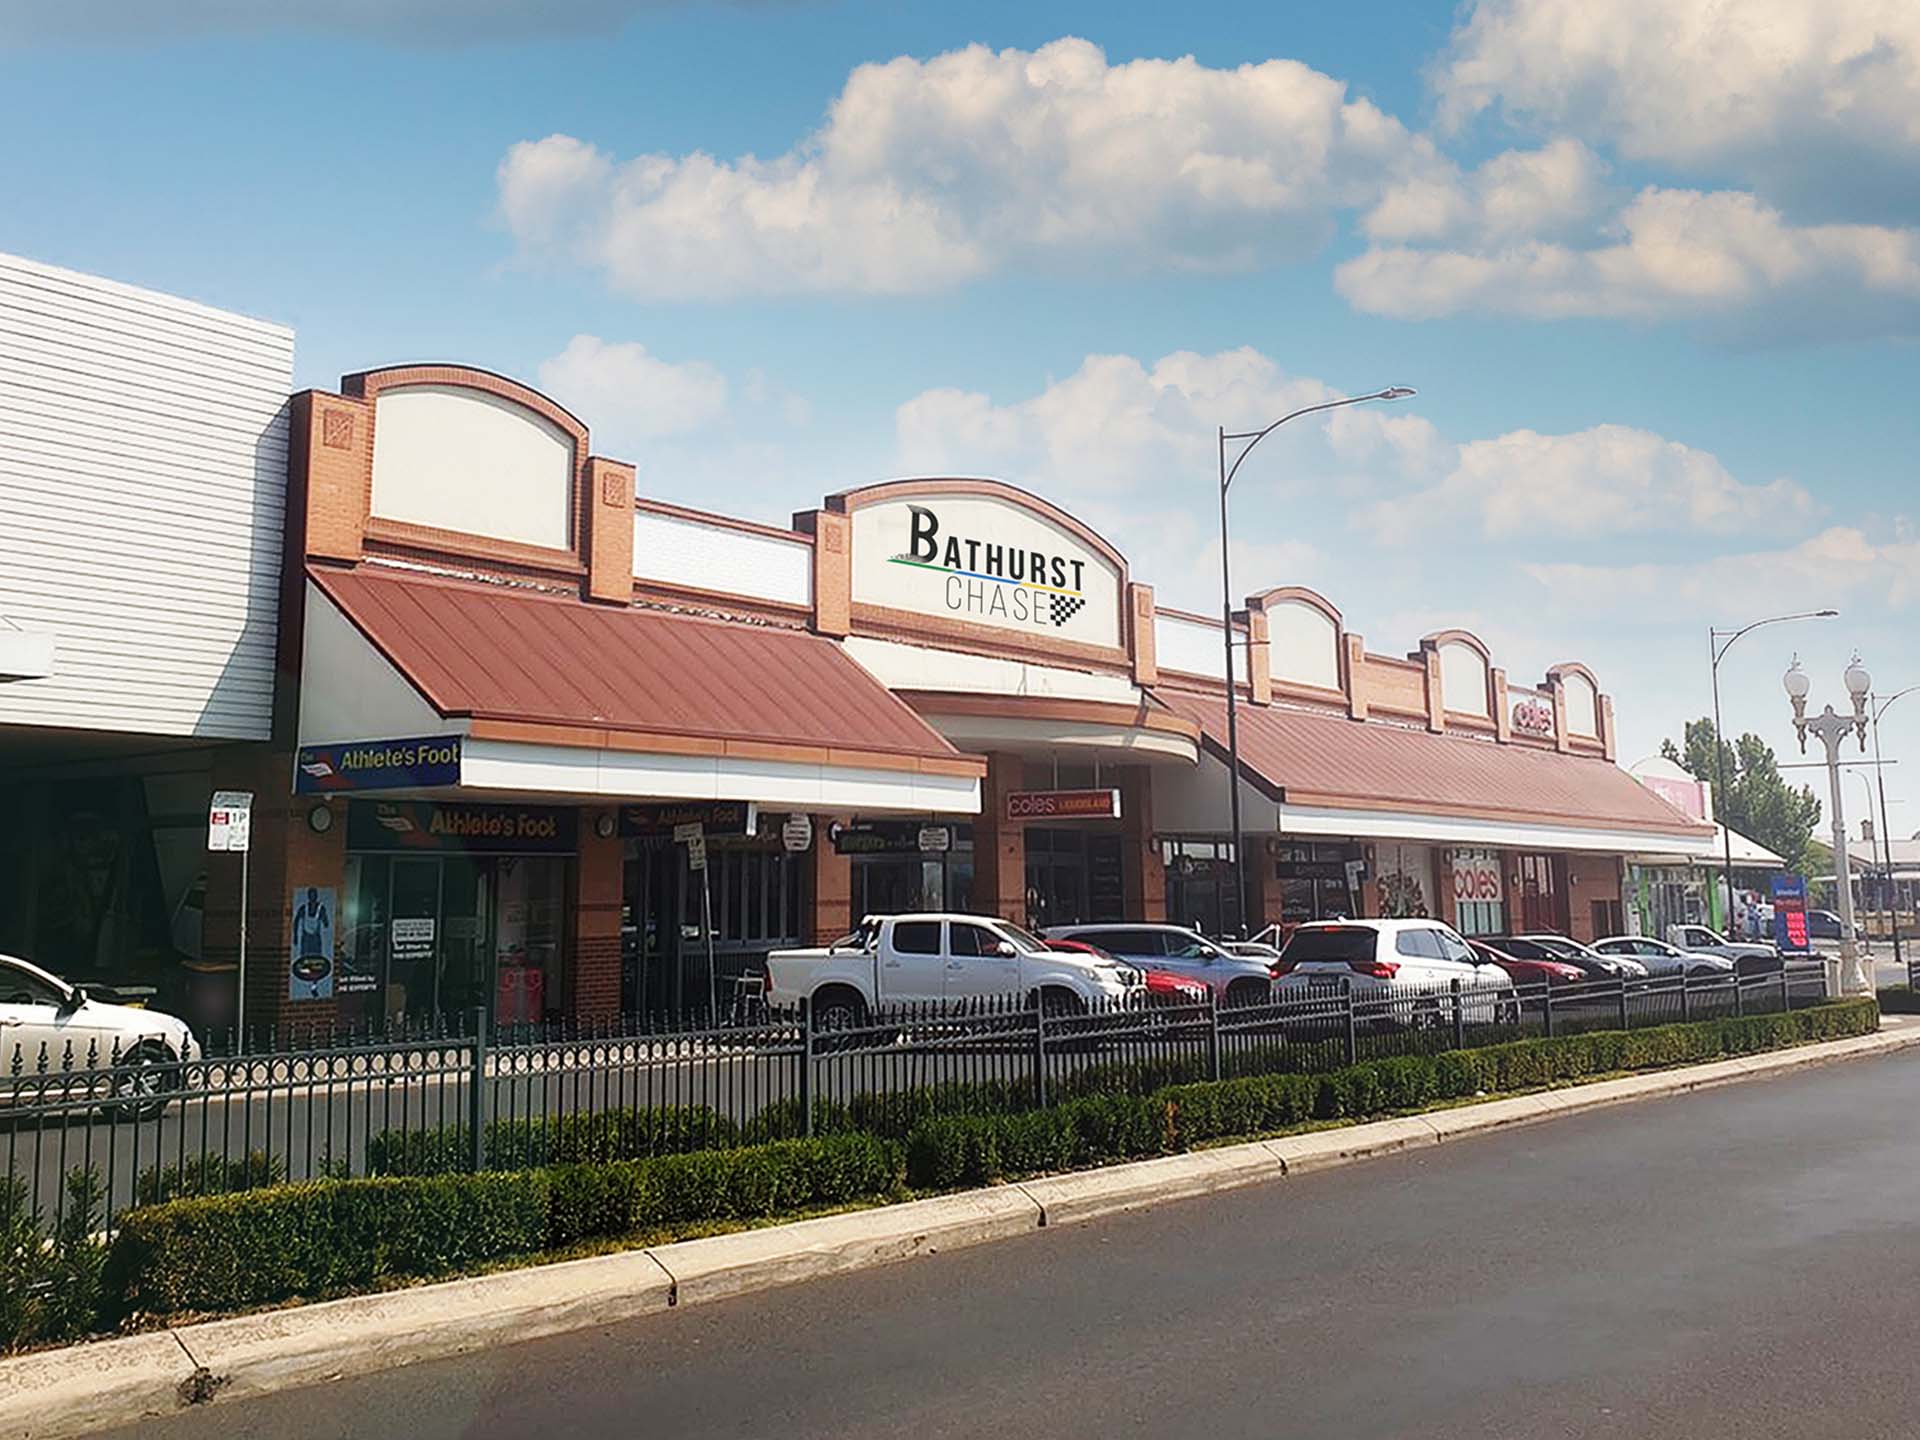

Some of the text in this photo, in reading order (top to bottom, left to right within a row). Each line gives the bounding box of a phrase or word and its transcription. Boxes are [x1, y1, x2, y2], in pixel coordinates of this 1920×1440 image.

[907, 503, 1086, 591] BATHURST
[945, 575, 1048, 625] CHASE
[340, 747, 415, 770] Athlete's
[417, 743, 459, 765] Foot
[1009, 794, 1056, 814] coles
[428, 809, 514, 837] Athlete's
[516, 812, 559, 838] Foot
[1454, 861, 1498, 899] coles
